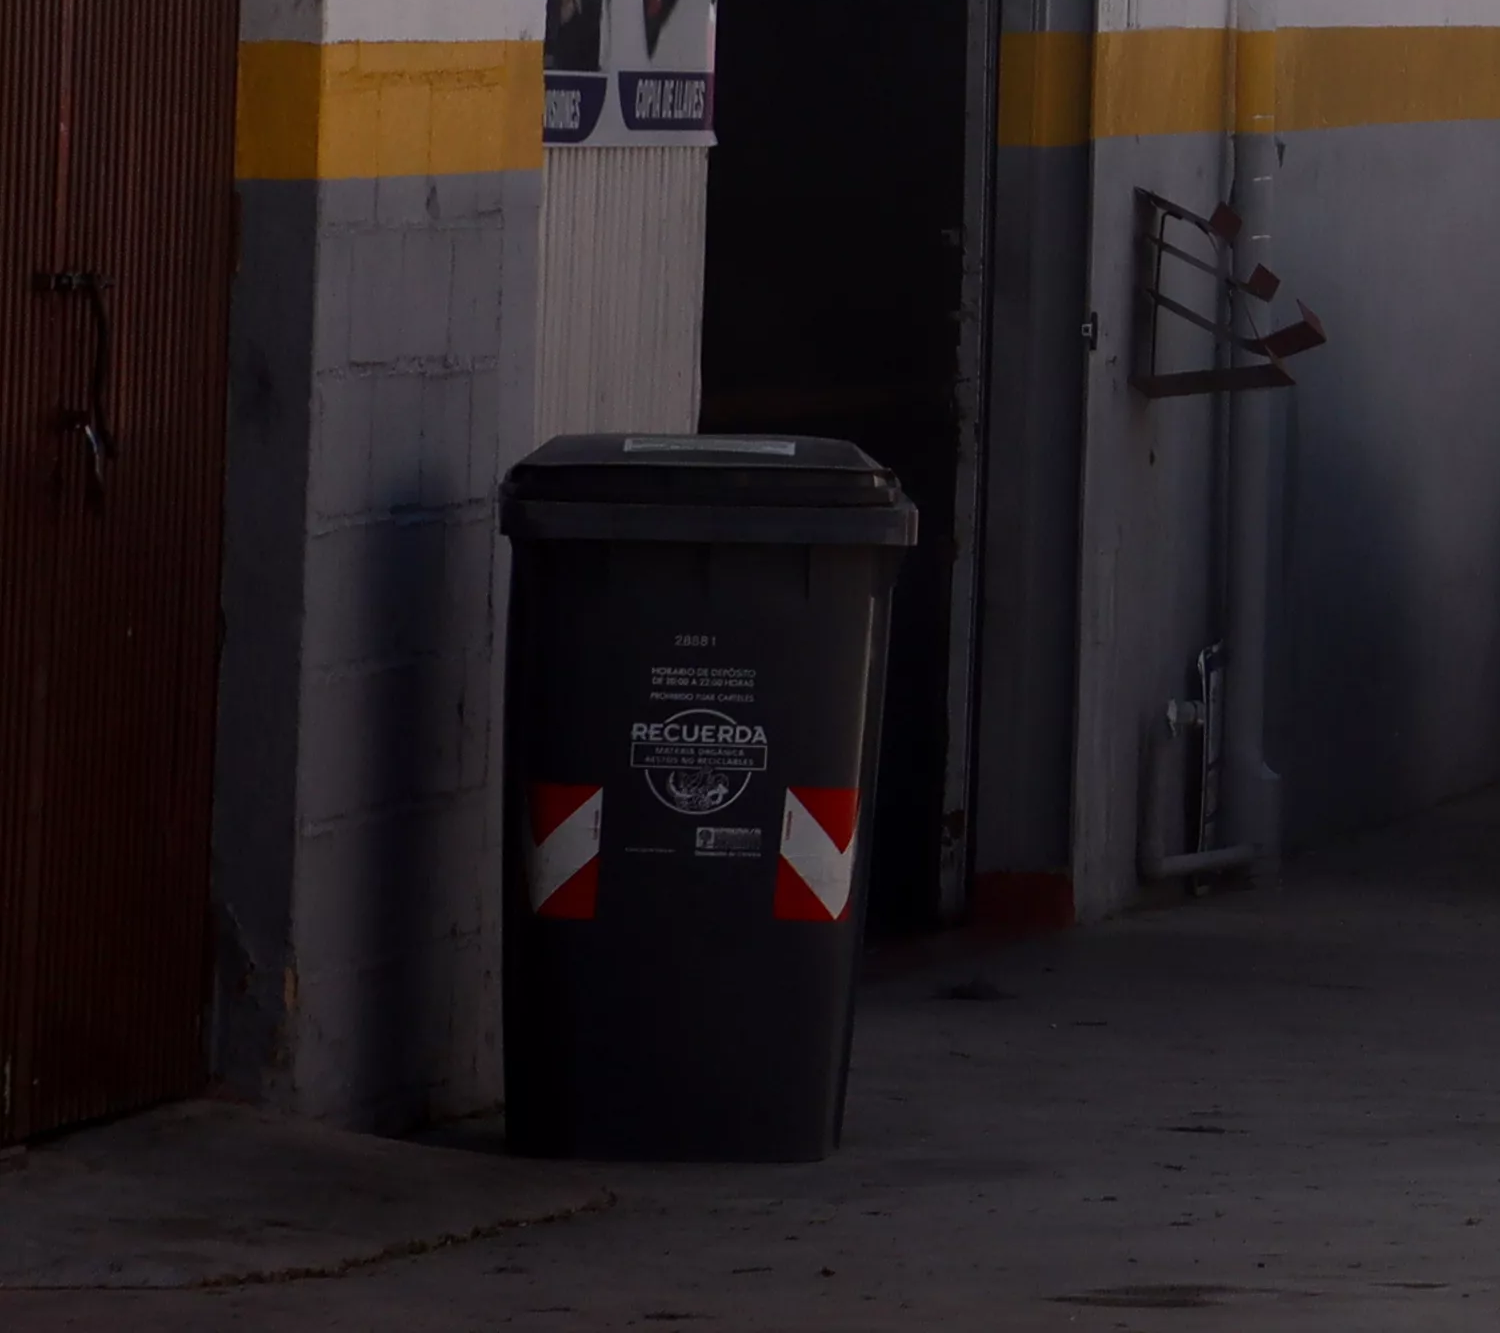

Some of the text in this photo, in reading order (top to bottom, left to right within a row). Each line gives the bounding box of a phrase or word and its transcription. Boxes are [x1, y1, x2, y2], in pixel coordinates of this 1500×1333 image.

[635, 79, 706, 119] COPIA DE LLAVES
[631, 723, 767, 744] RECUERDA
